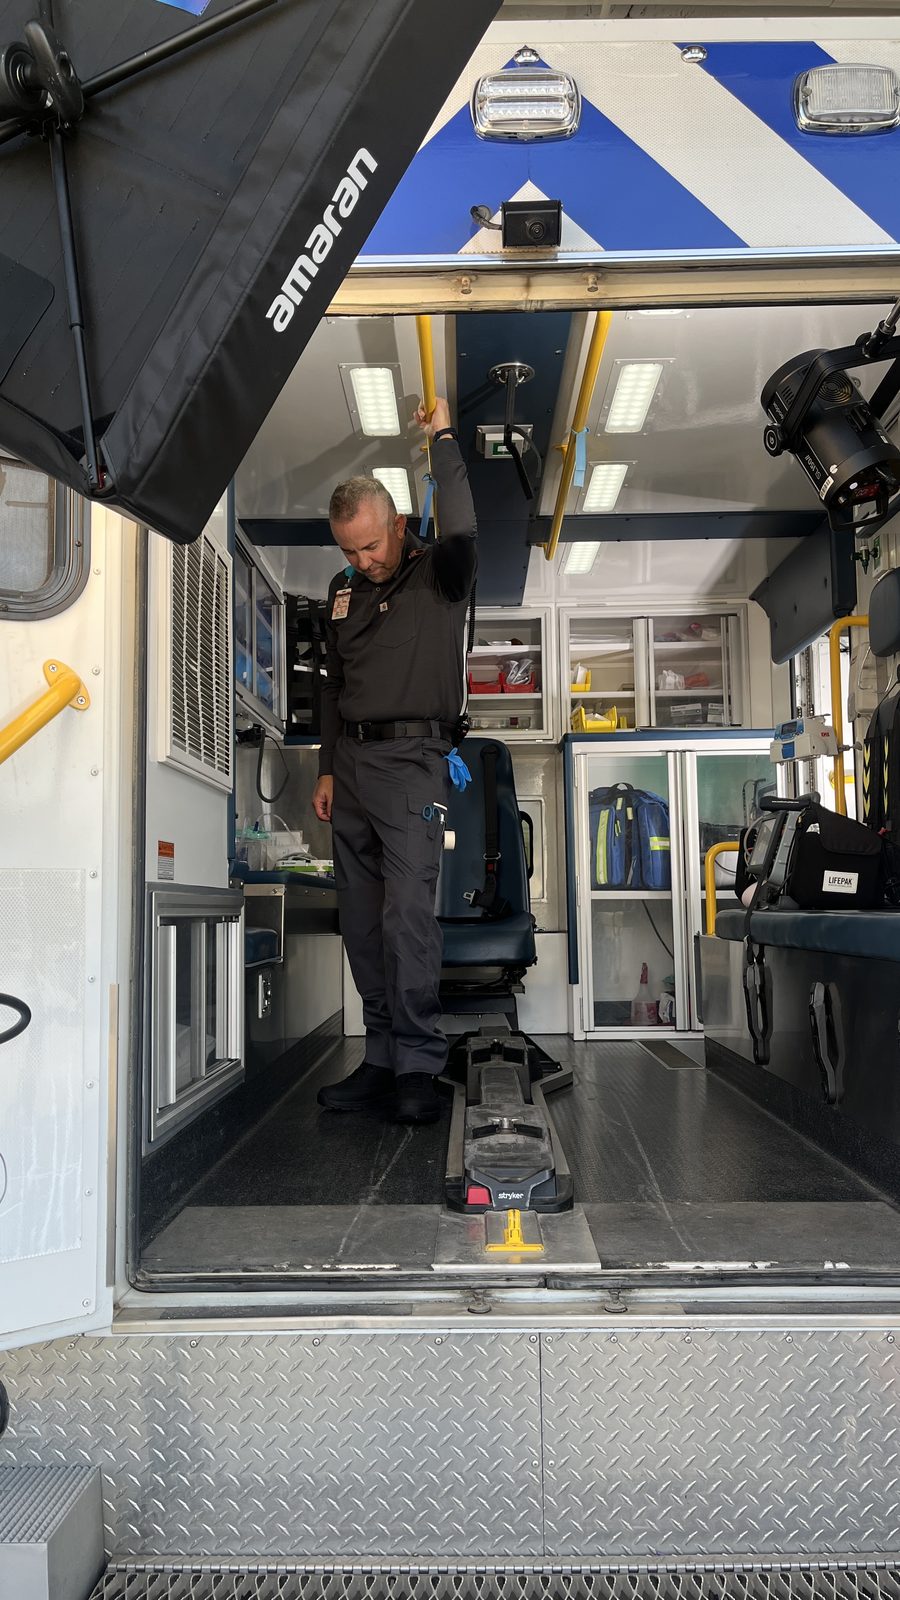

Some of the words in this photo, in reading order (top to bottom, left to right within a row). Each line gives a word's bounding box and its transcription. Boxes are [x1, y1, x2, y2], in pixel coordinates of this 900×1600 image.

[265, 147, 378, 332] amaran
[828, 876, 852, 885] LIFEPAK
[498, 1192, 524, 1200] stryker
